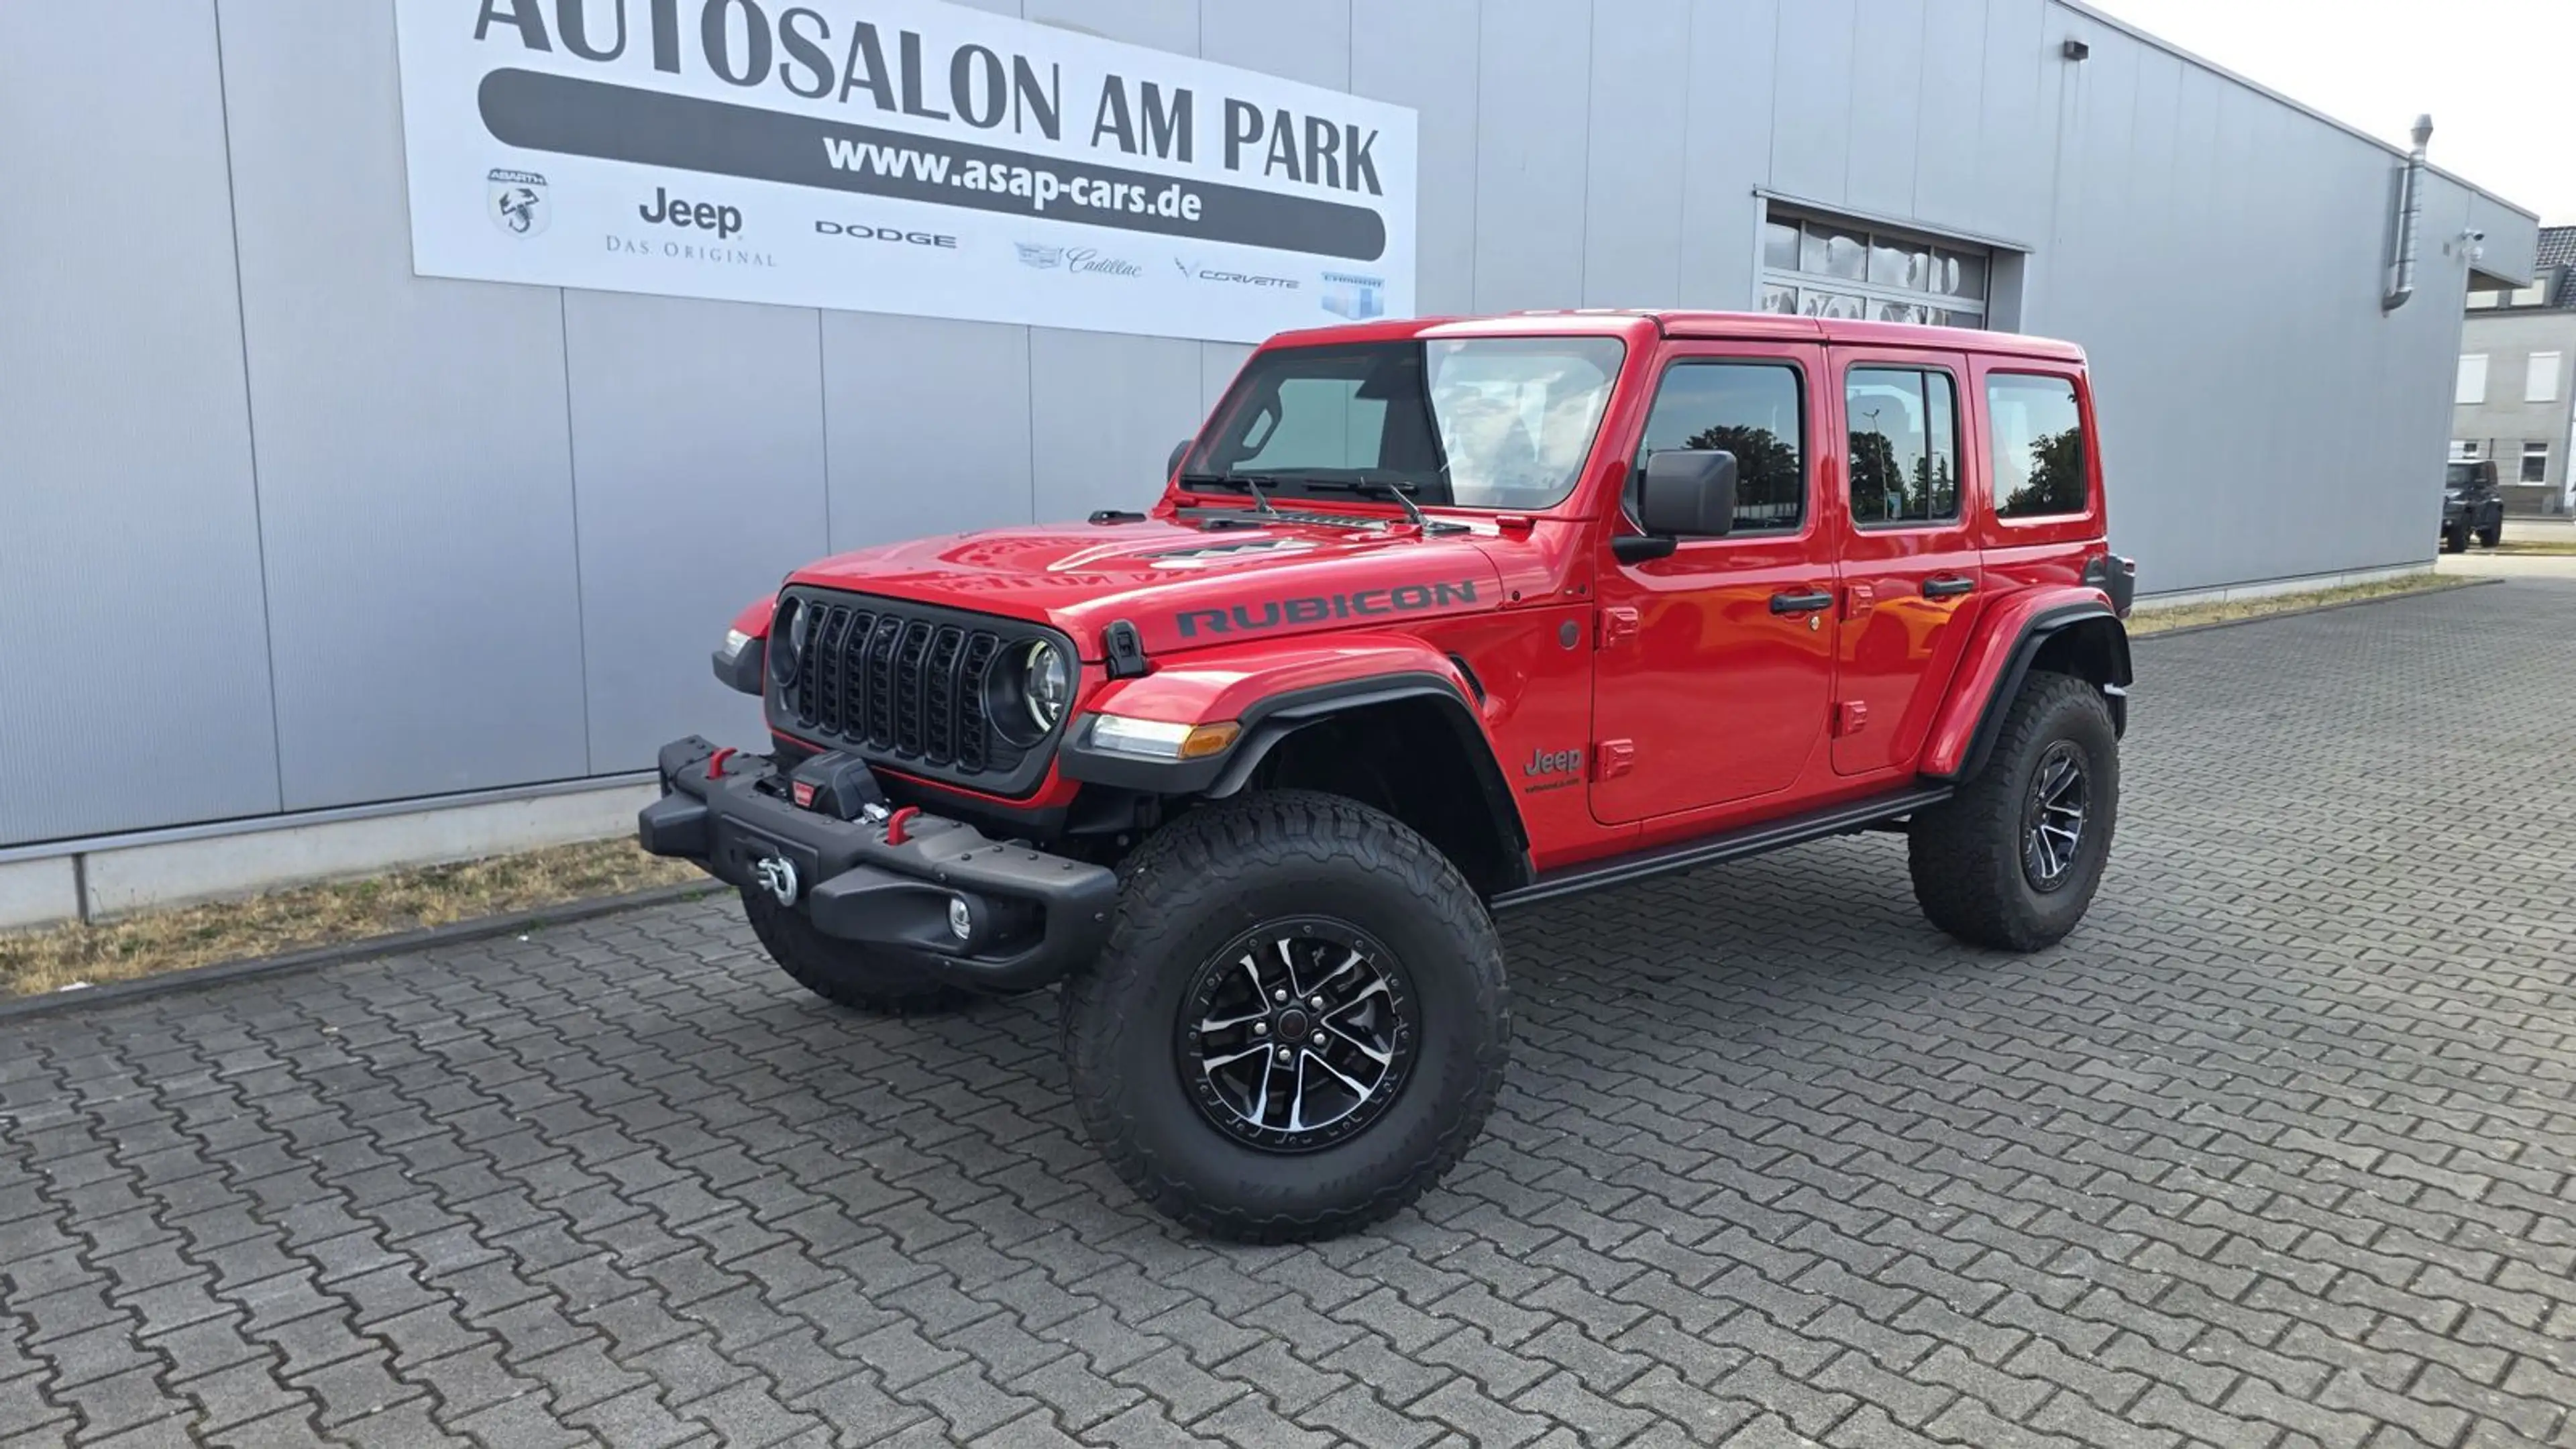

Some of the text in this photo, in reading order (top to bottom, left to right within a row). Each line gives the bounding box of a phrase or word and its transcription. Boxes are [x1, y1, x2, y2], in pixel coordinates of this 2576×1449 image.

[1091, 74, 1193, 163] AM
[1224, 97, 1383, 196] PARK
[490, 170, 545, 184] ABARTH
[823, 138, 1202, 221] www.asap-cars.de
[639, 186, 742, 239] Jeep
[606, 235, 777, 267] DAS ORIGINAL
[815, 221, 957, 249] DODGE
[1066, 246, 1142, 278] Cadillac
[1199, 270, 1301, 288] CORVETTE
[1176, 580, 1478, 638] RUBICON
[1523, 748, 1582, 776] Jeep
